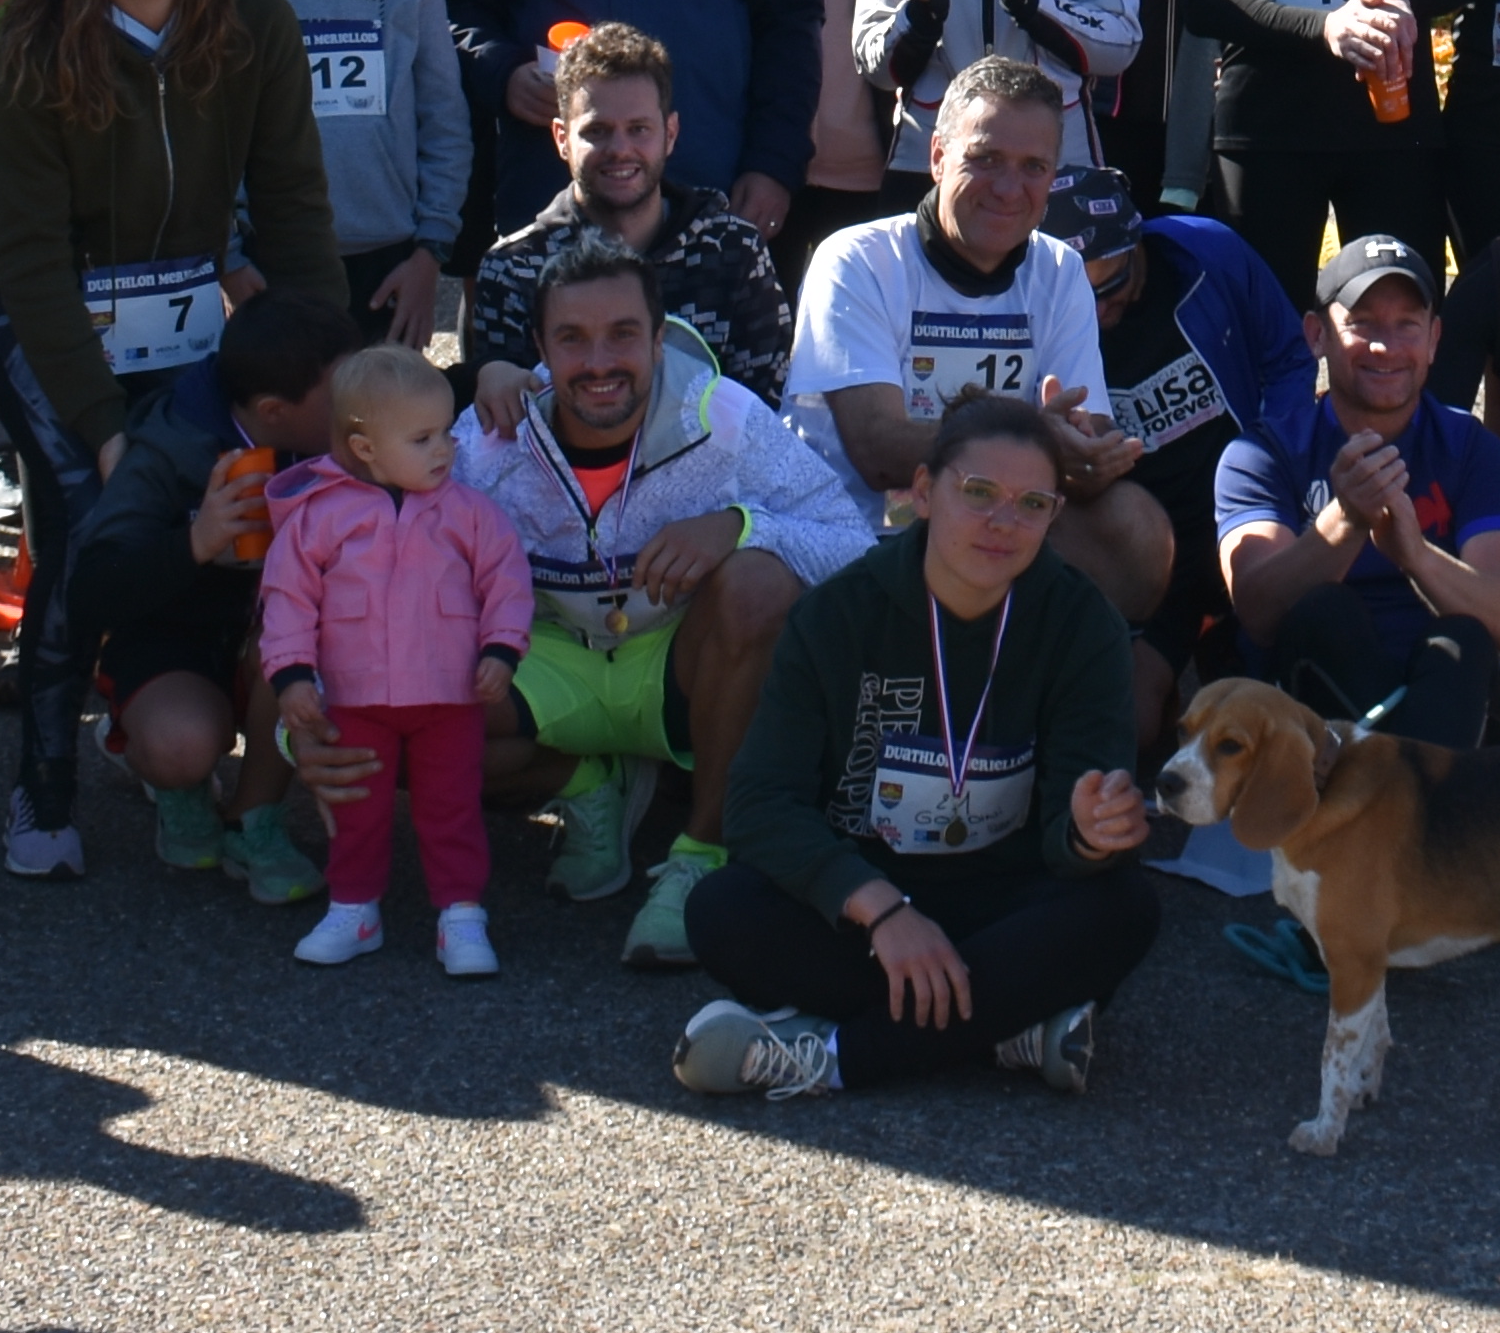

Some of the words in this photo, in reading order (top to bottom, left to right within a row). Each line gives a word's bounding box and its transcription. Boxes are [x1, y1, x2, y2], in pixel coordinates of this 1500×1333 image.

[311, 55, 367, 90] 12
[168, 294, 194, 333] 7
[975, 353, 1023, 391] 12
